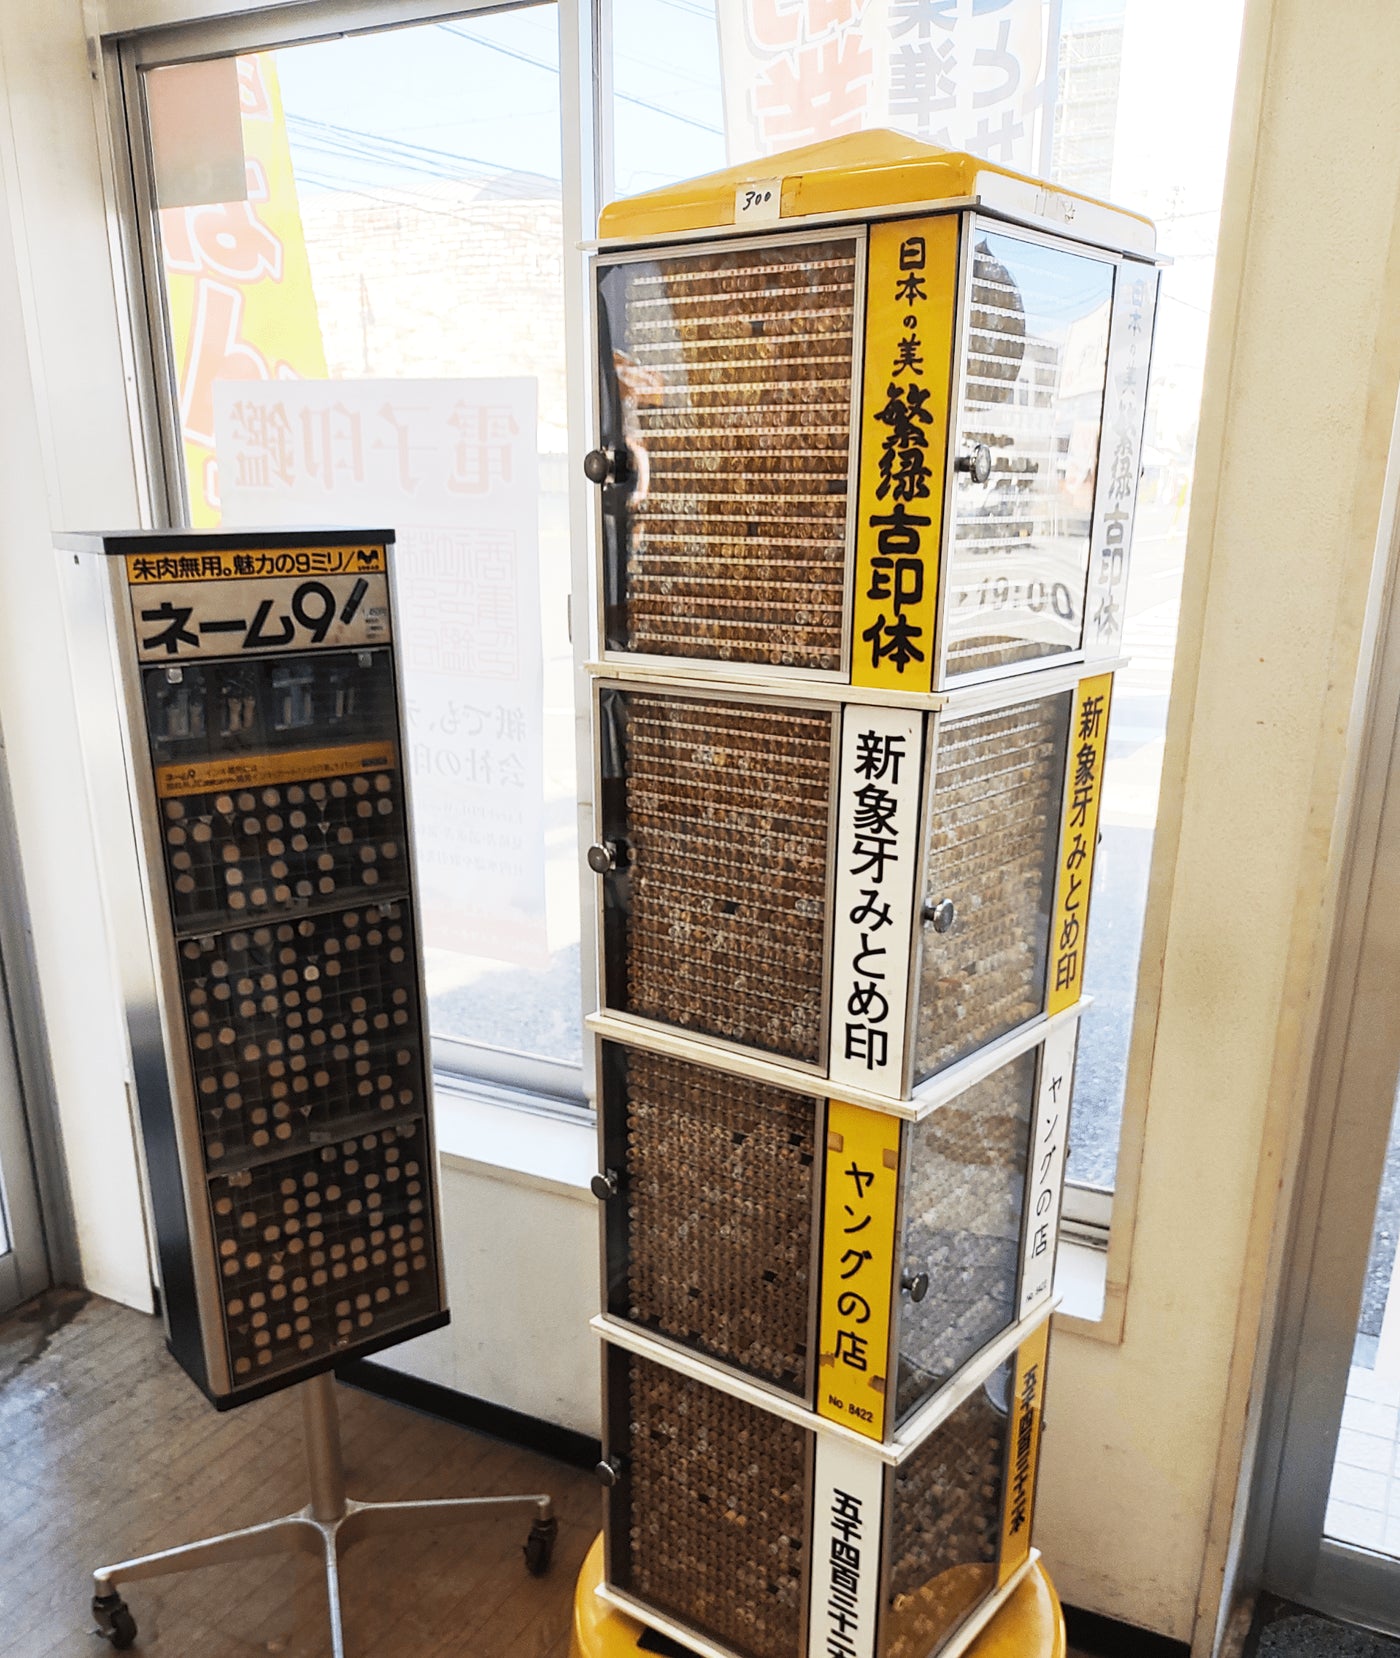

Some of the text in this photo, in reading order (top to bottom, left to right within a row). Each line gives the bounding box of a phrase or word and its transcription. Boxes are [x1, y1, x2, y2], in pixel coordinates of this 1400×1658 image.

[742, 191, 772, 211] 300
[141, 580, 337, 654] ネーム9
[844, 730, 907, 1070] 新象牙みとめ印
[1055, 695, 1104, 991] 新象牙みとめ印
[1031, 1075, 1062, 1259] ヤングの店
[834, 1162, 875, 1371] ヤングの店
[848, 1403, 874, 1424] 8422
[827, 1487, 862, 1658] 五千四百三十二
